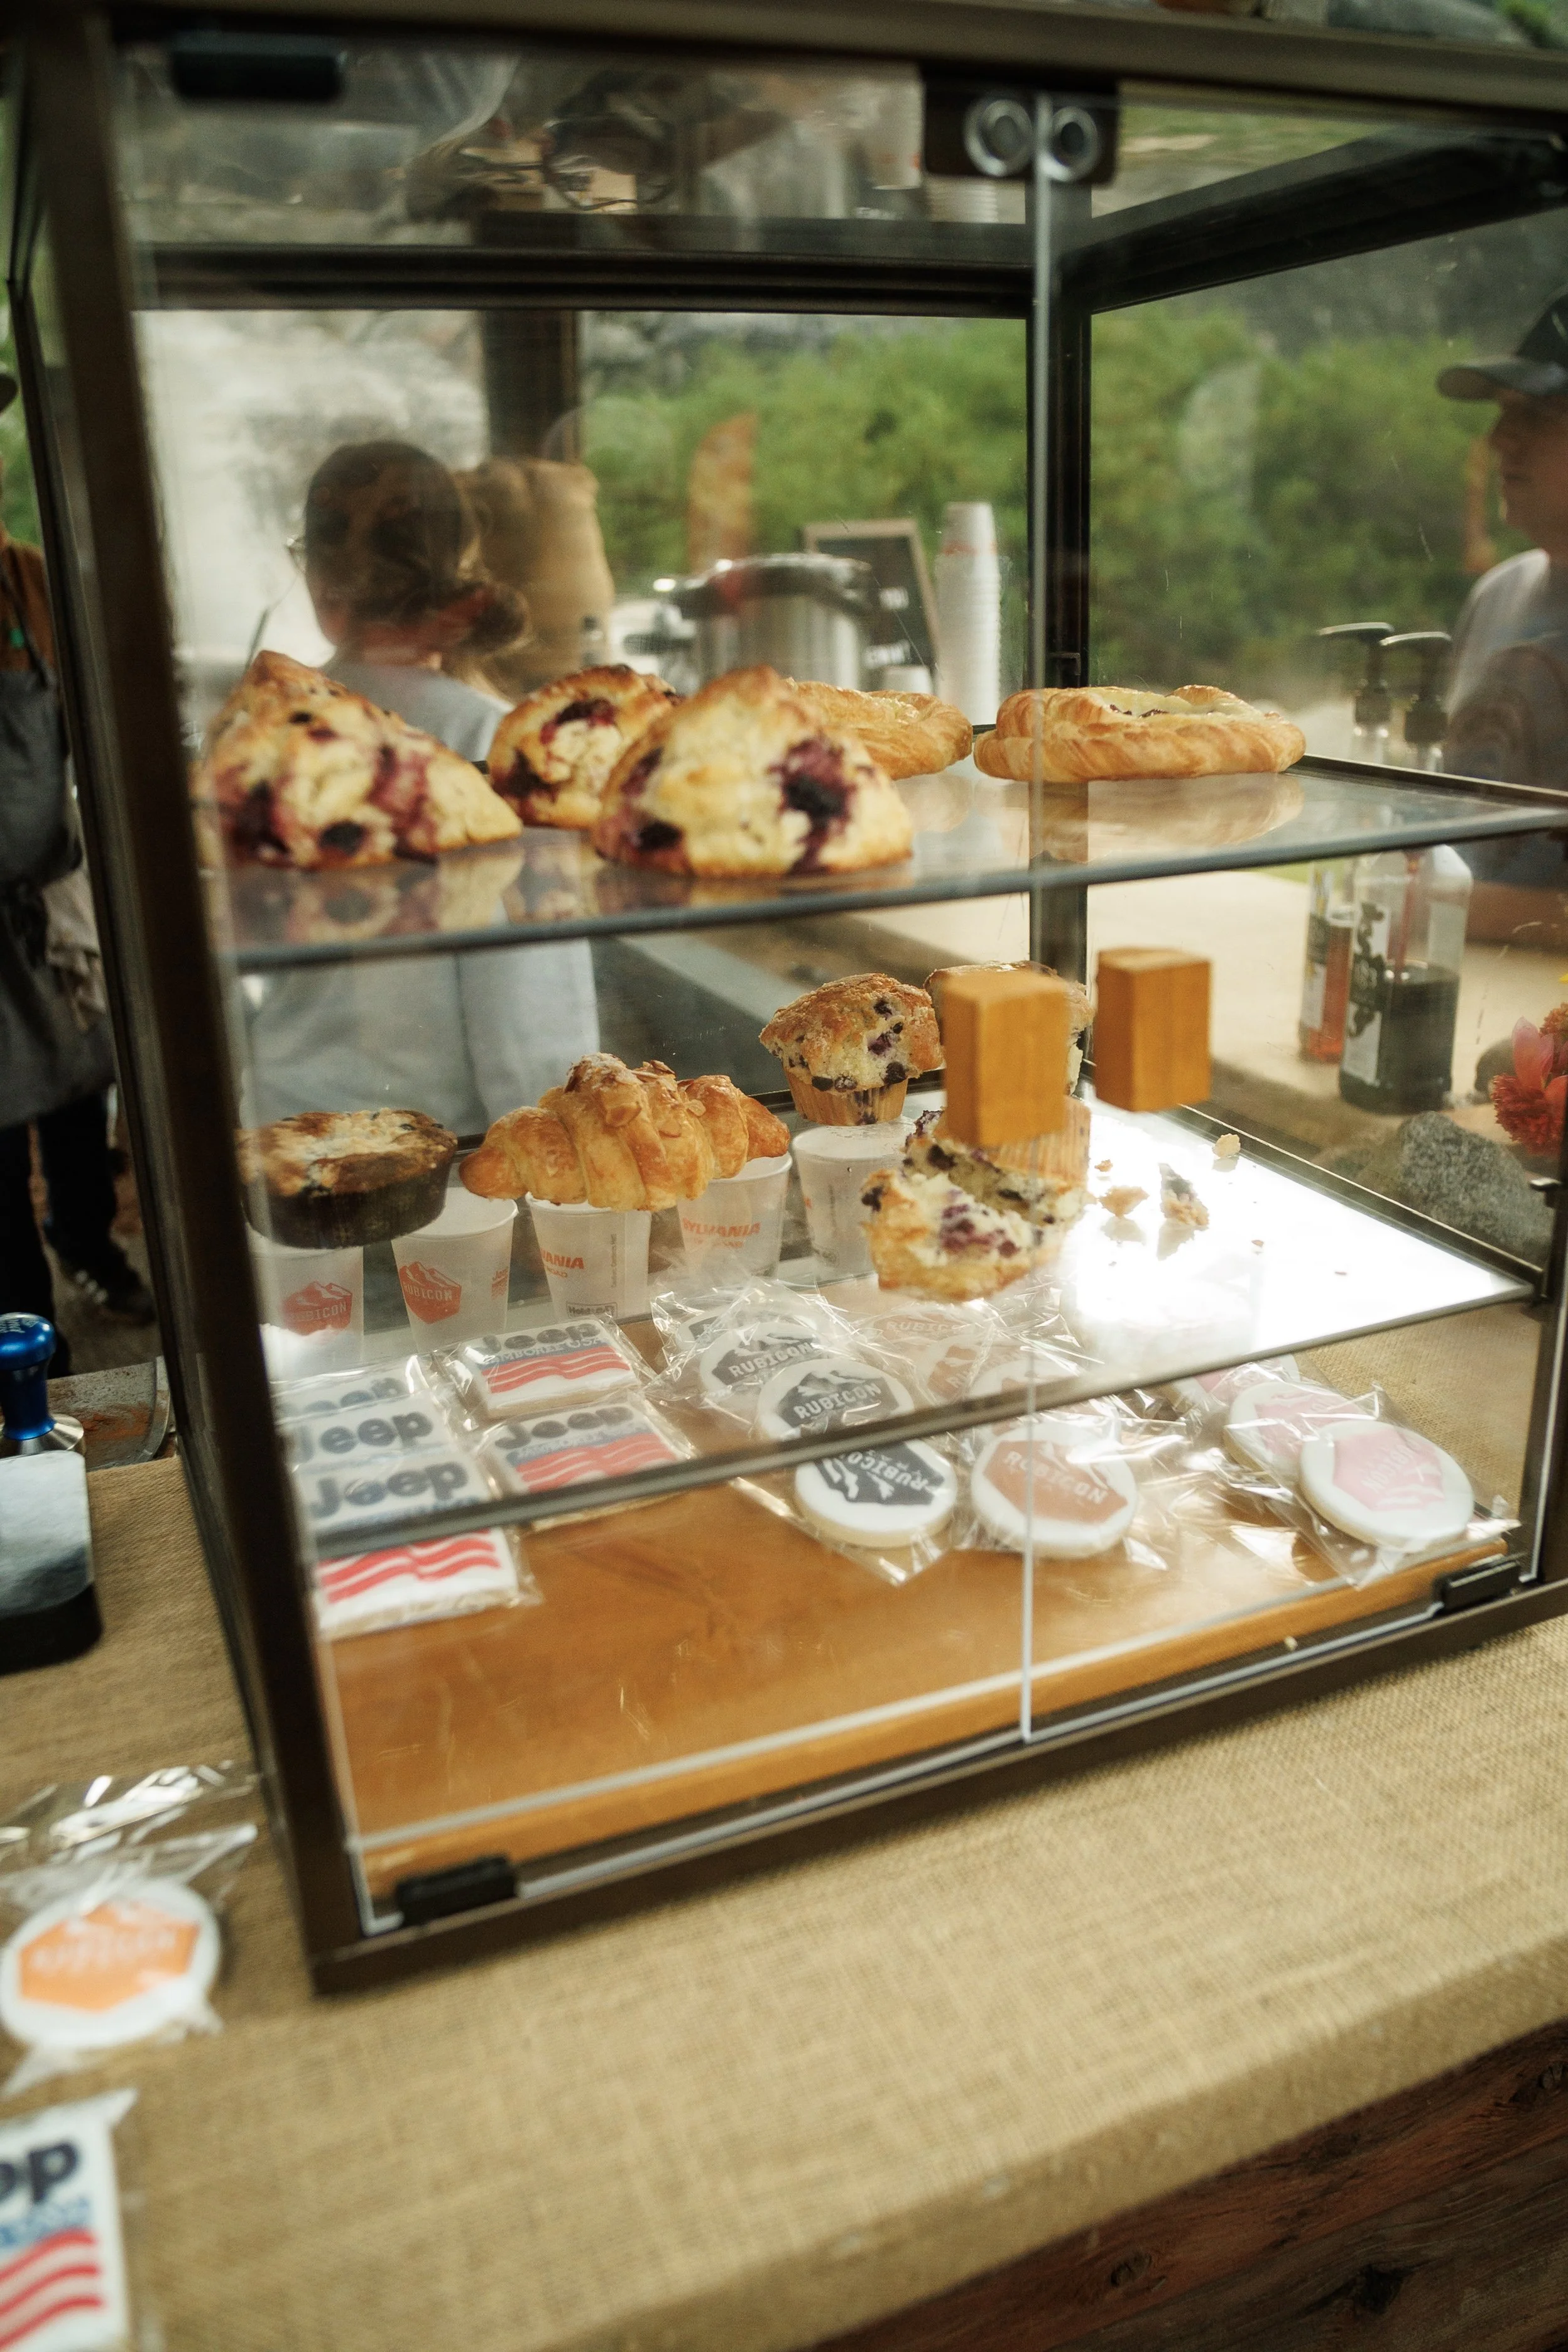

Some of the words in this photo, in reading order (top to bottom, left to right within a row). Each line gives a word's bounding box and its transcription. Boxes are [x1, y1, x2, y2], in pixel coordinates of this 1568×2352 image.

[401, 1281, 453, 1302] RUBICON
[482, 1343, 565, 1365] AMBOREE
[728, 1341, 816, 1378] RUBICON
[793, 1382, 882, 1420] RUBICON
[286, 1411, 433, 1464] Jeep
[839, 1449, 929, 1491] RUBICO
[310, 1461, 469, 1520] Jeep
